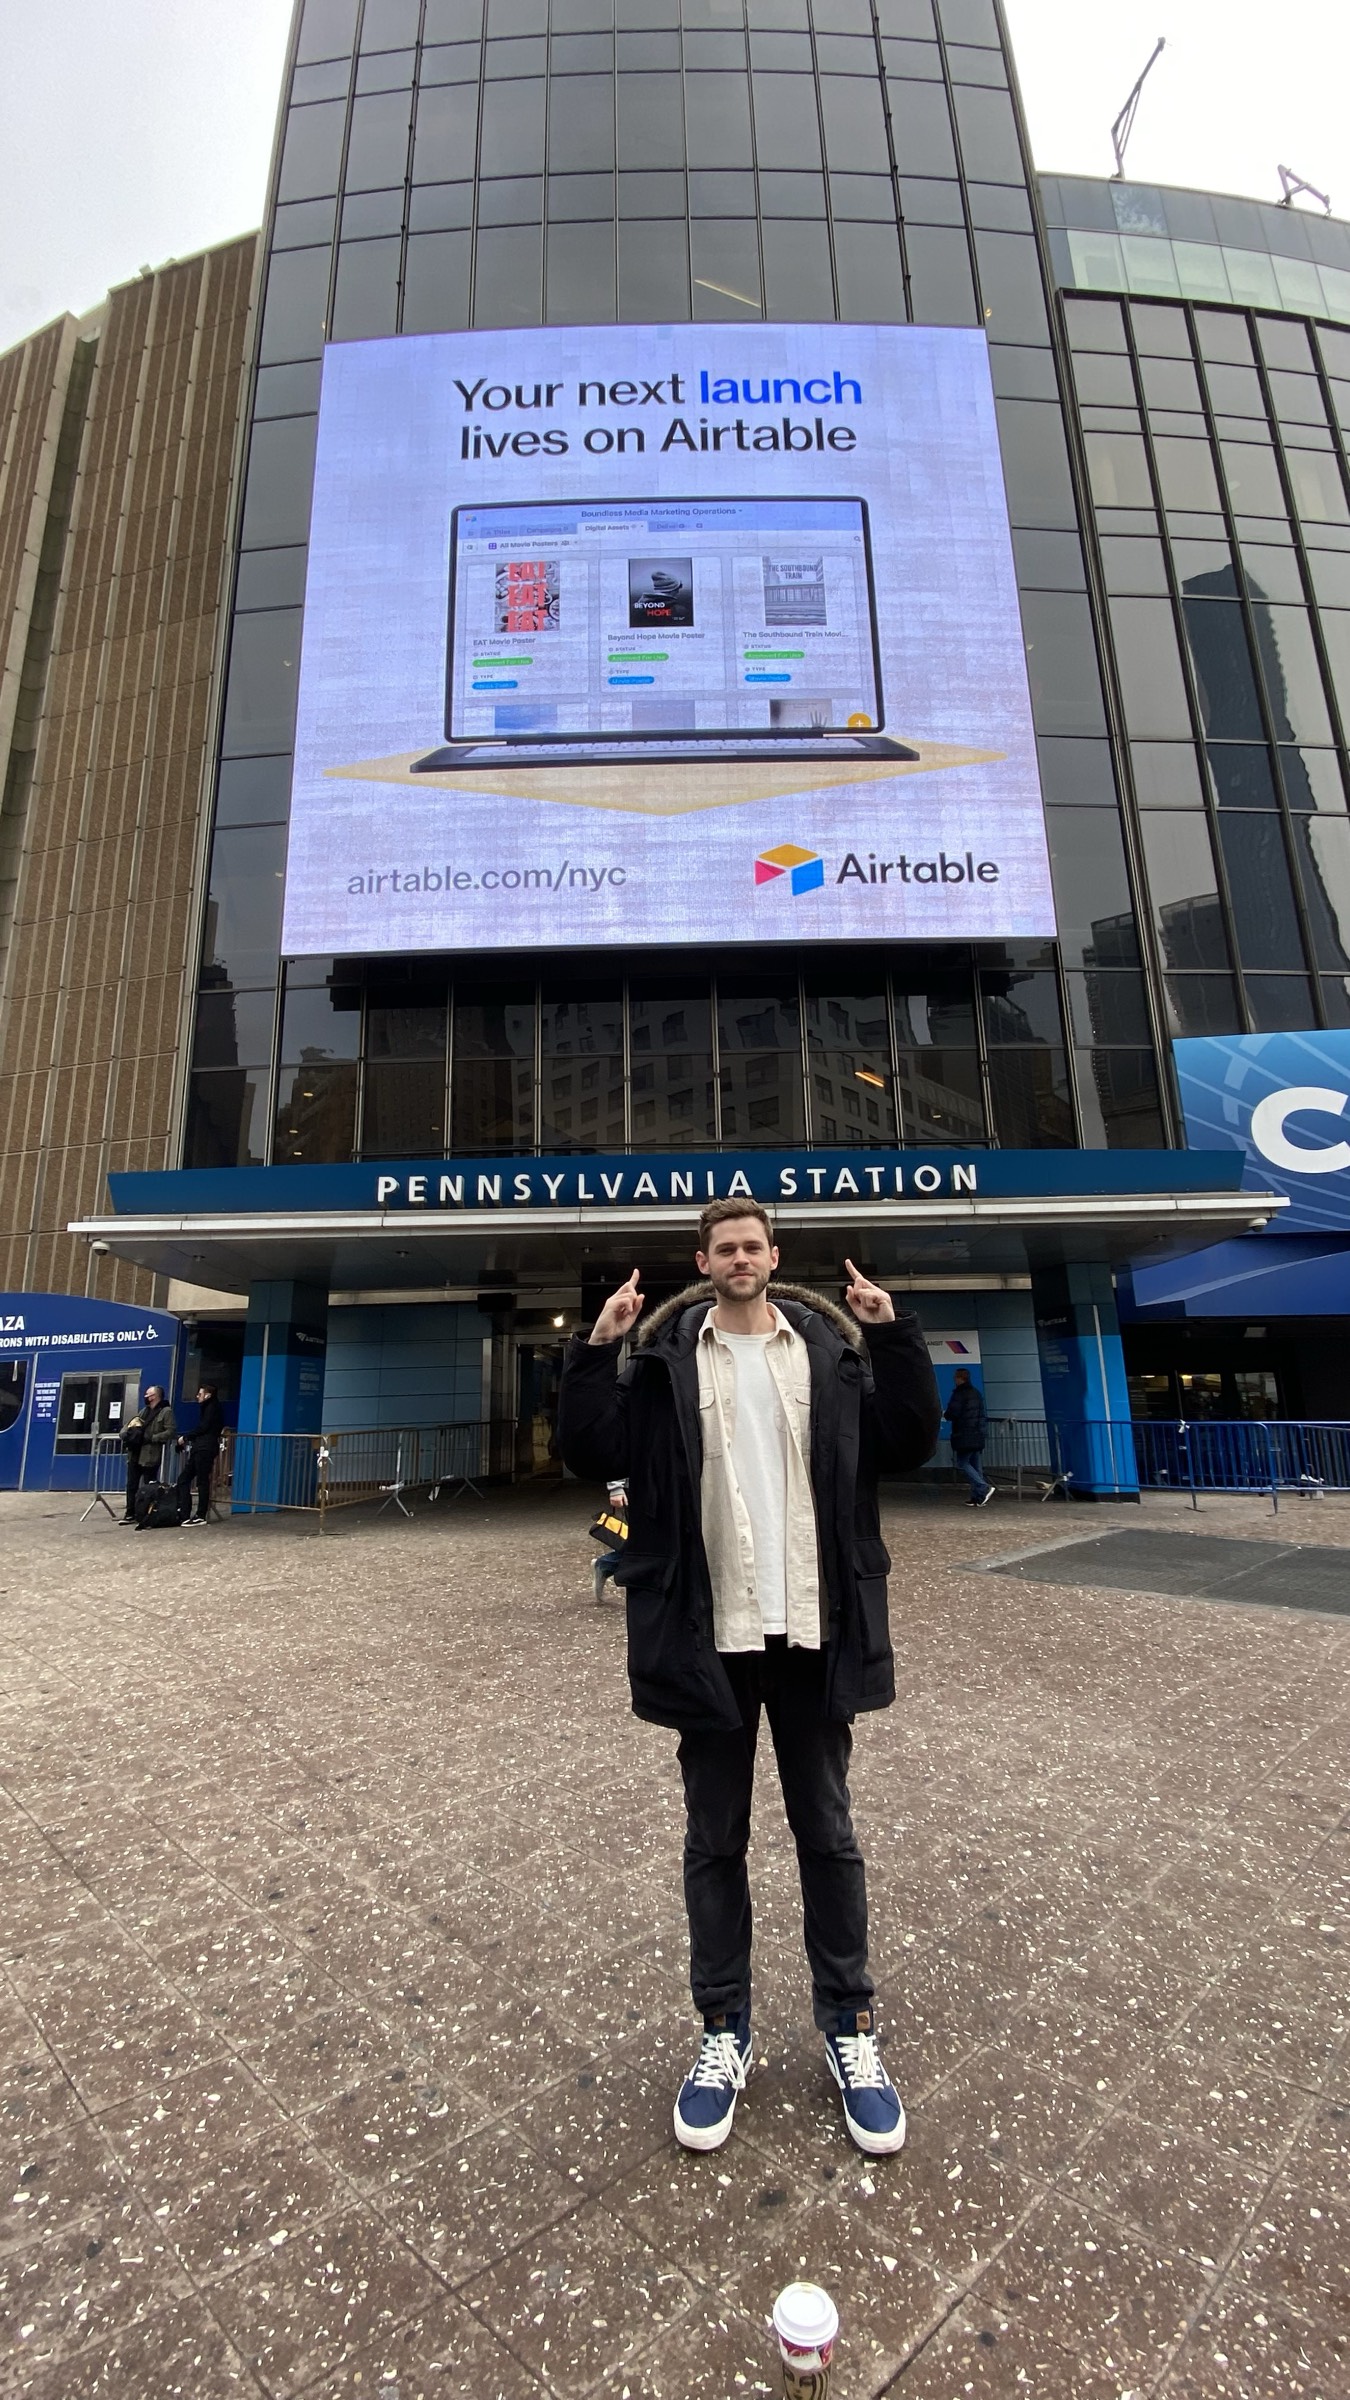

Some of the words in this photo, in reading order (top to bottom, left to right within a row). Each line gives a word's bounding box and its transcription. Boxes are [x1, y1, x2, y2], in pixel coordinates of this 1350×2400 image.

[452, 378, 564, 412] Your
[578, 373, 685, 406] next
[700, 370, 862, 404] launch
[460, 425, 569, 460] lives
[583, 427, 645, 453] on
[660, 417, 857, 452] Airtable
[581, 509, 623, 518] Boundless
[624, 508, 649, 516] Media
[650, 508, 690, 517] Marketing
[692, 507, 736, 516] Operations
[585, 524, 606, 532] Digital
[532, 540, 558, 548] Posters
[768, 564, 780, 572] THE
[780, 564, 818, 572] SOUTHBOUND
[785, 572, 803, 580] TRAIN
[508, 583, 548, 607] EAT
[507, 609, 548, 633] EAT
[608, 634, 635, 642] Beyond
[637, 633, 657, 641] Hope
[346, 860, 627, 897] airtable.com/nyc
[836, 852, 1000, 885] Airtable
[1250, 1086, 1350, 1174] C
[376, 1170, 753, 1202] PENNSYLVANIA
[779, 1163, 978, 1197] STATION
[25, 1335, 49, 1347] WITH
[51, 1332, 115, 1345] DISABILITIES
[116, 1330, 145, 1342] ONLY
